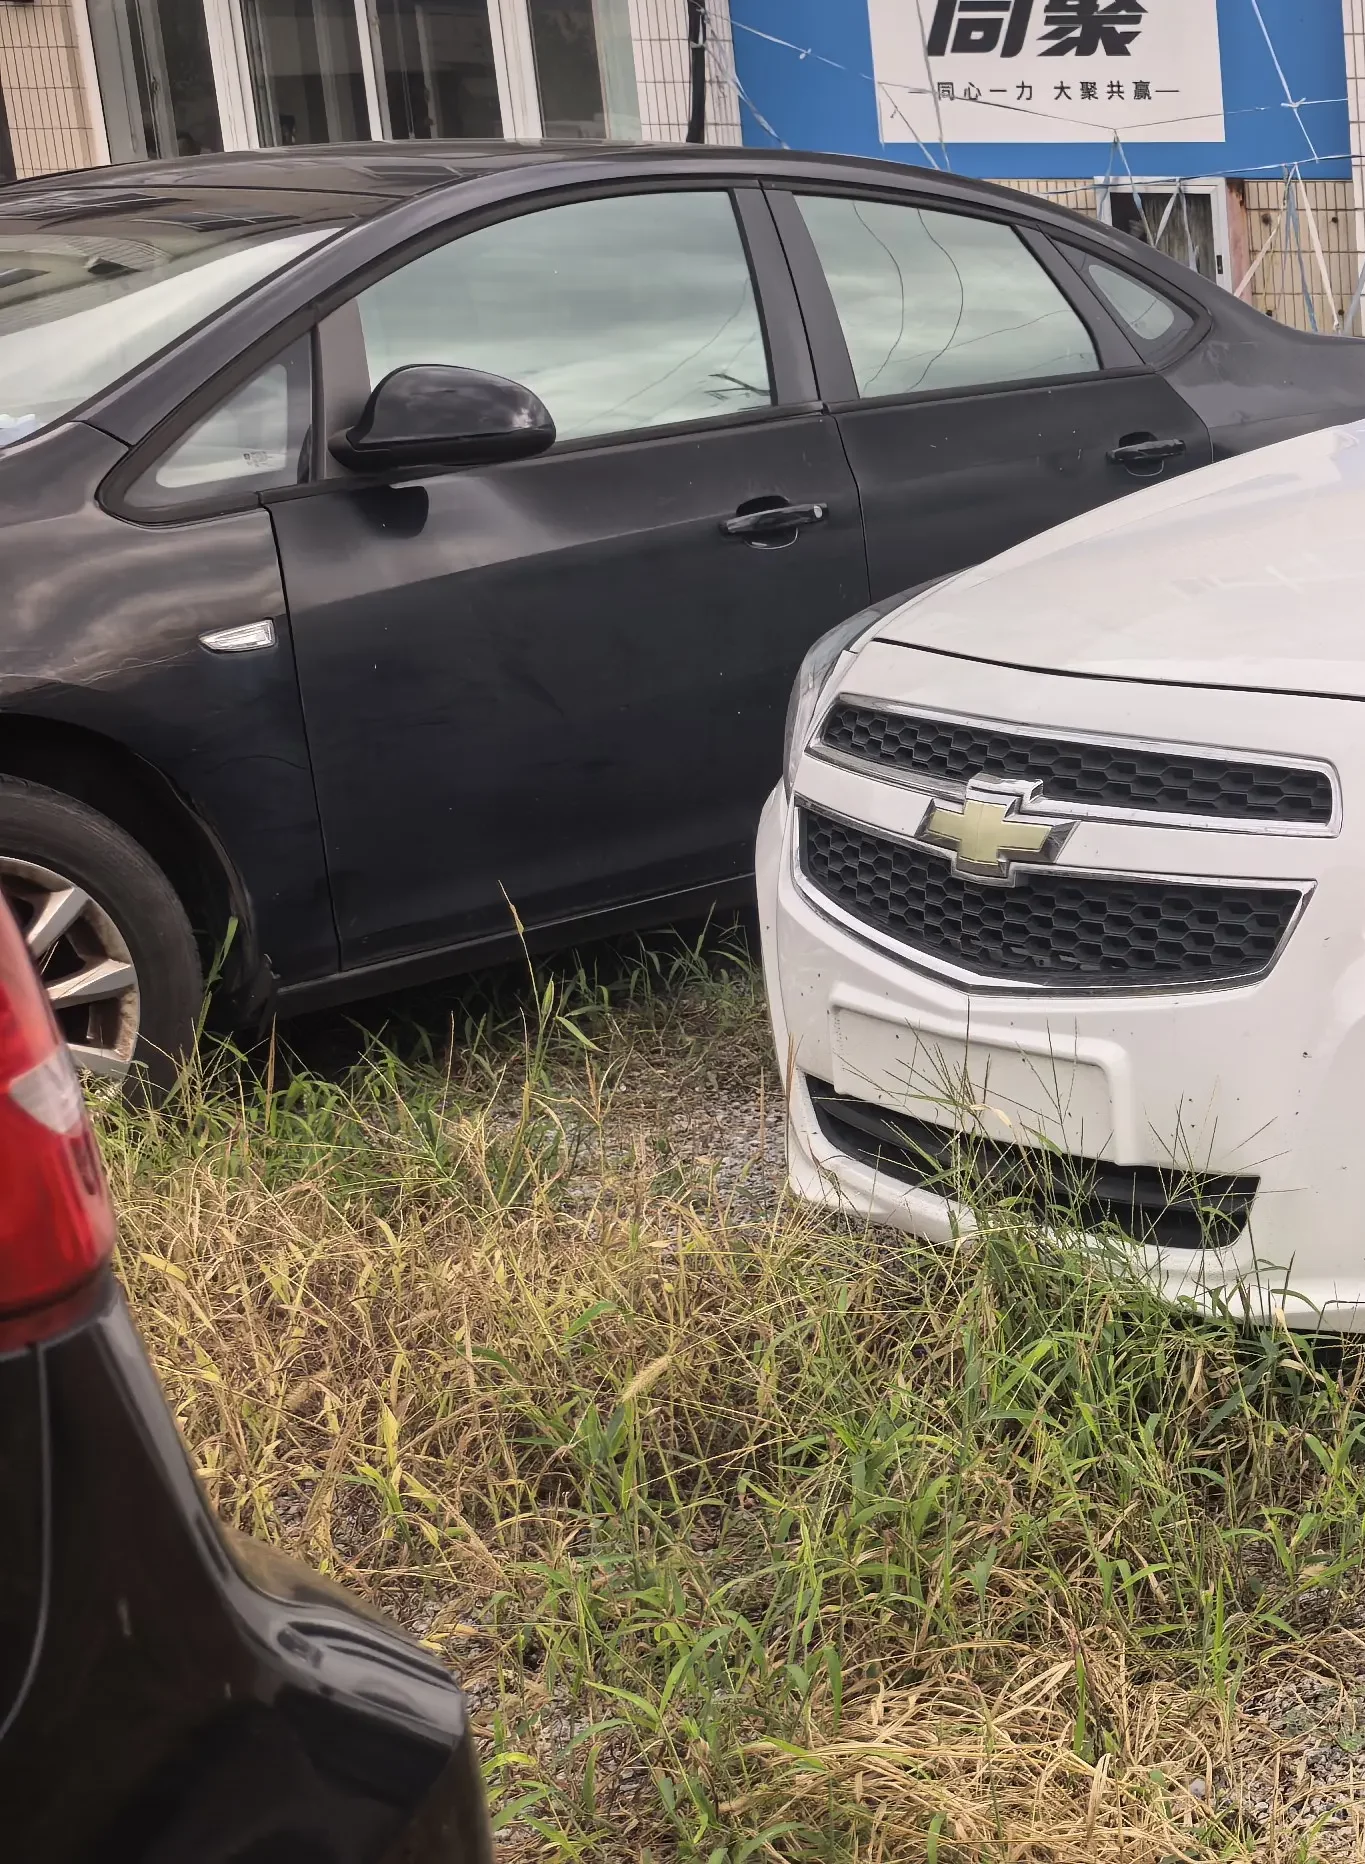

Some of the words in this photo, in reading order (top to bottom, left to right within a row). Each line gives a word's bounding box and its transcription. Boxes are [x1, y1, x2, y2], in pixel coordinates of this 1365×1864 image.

[926, 0, 1149, 58] 同聚
[937, 82, 1033, 100] 同心一力
[1053, 81, 1152, 100] 大聚共赢
